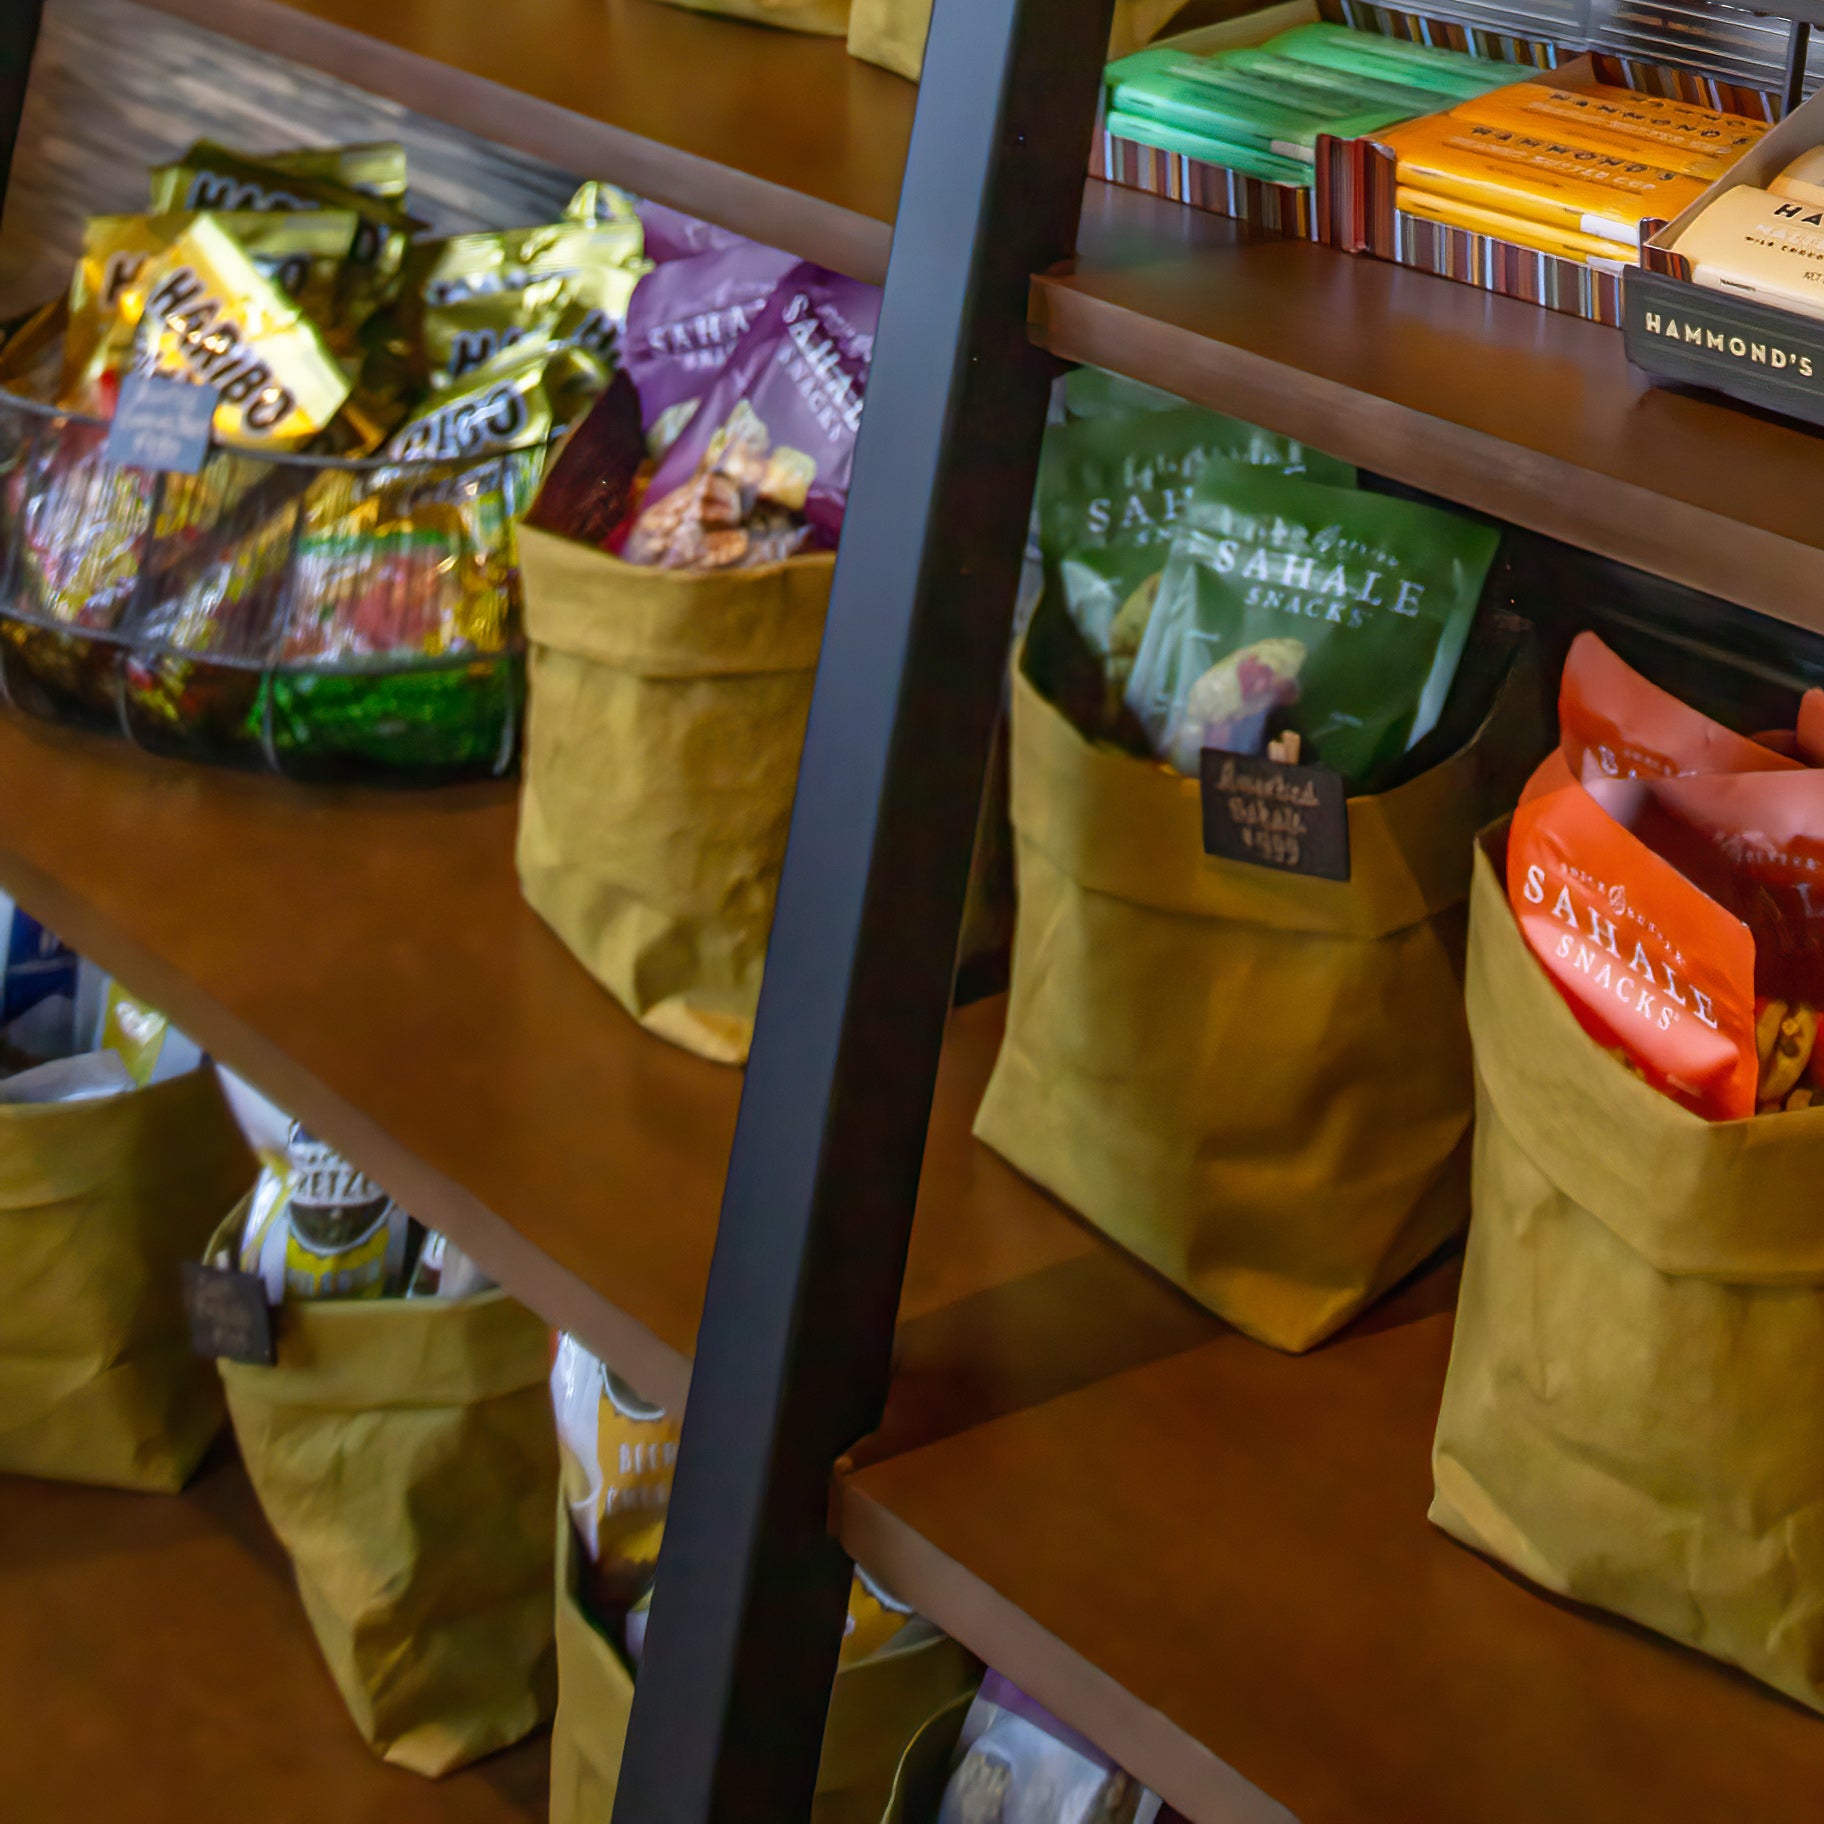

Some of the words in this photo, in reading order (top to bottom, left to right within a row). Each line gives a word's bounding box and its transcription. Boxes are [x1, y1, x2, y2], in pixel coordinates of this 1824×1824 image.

[150, 267, 296, 435] HARIBO
[1645, 312, 1813, 377] HAMMOND'S
[1087, 487, 1196, 533] SAH
[1212, 540, 1426, 618] SAHALE
[1245, 587, 1370, 628] SNACKS
[1522, 864, 1719, 1030] SAHALE
[1556, 934, 1675, 1031] SNACKS
